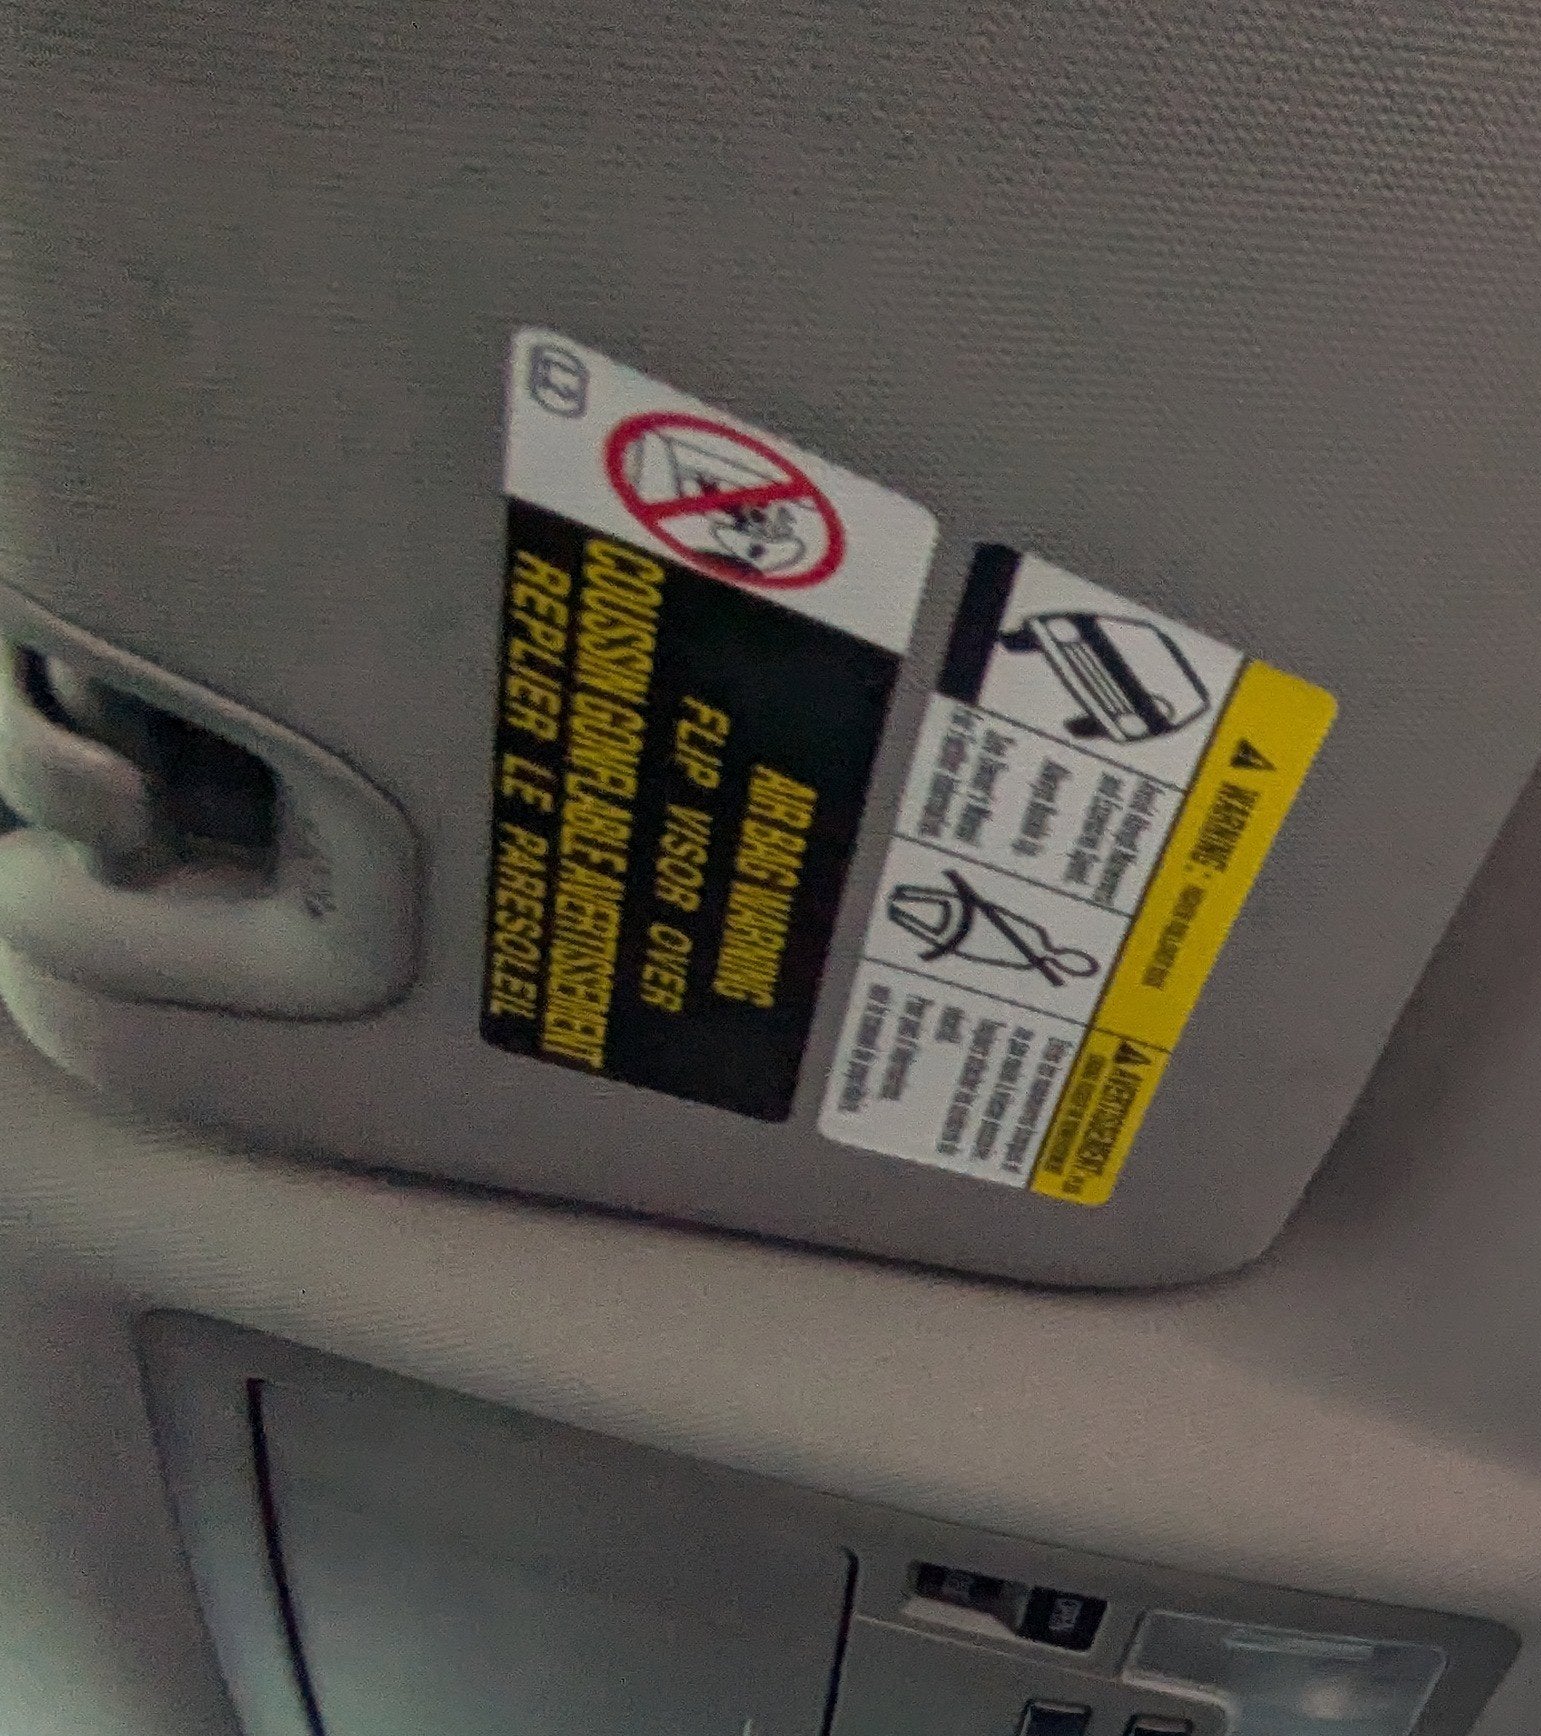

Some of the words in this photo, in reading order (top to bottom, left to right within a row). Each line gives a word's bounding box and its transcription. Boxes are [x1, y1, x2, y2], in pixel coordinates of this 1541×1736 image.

[508, 553, 571, 739] REPLIER
[577, 540, 665, 702] COUSSIN
[503, 756, 552, 809] LE
[560, 693, 645, 871] GONFLABLE
[677, 698, 728, 788] FLIP
[749, 766, 816, 829] AIR
[658, 806, 708, 911] VISOR
[737, 818, 805, 888] BAG
[494, 825, 547, 1015] PARESOLEIL
[544, 860, 622, 1066] AVERTISSEMENT
[643, 925, 690, 1011] OVER
[715, 882, 789, 1006] WARNING
